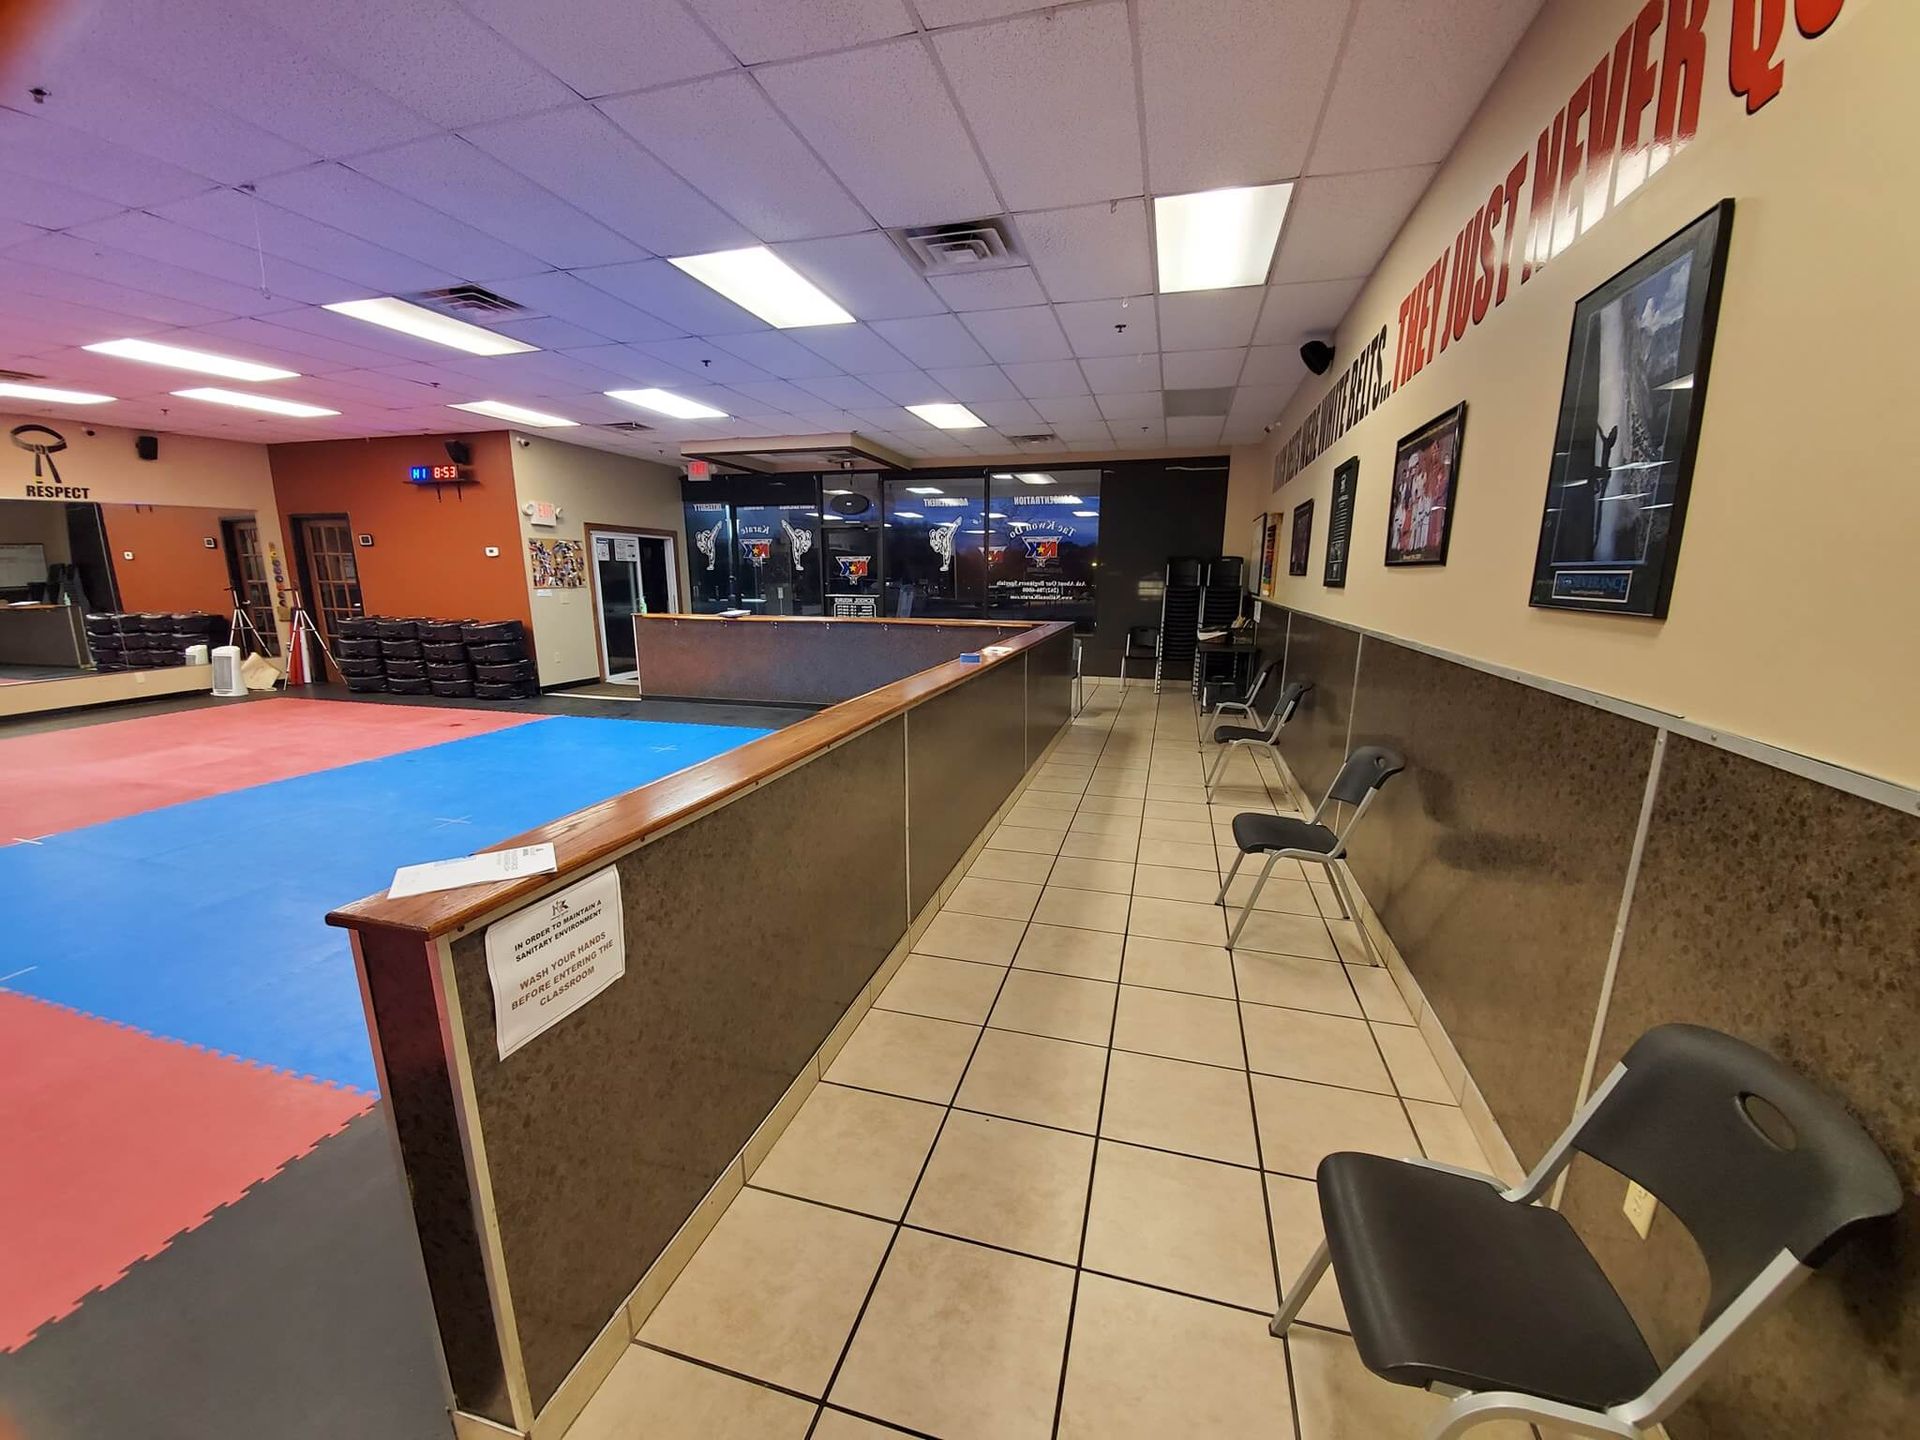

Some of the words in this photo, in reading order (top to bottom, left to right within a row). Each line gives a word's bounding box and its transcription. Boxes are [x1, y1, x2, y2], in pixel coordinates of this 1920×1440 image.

[1393, 247, 1450, 394] THEY
[1440, 153, 1528, 353] JUST
[1521, 0, 1709, 285] NEVER
[26, 485, 90, 499] RESPECT
[434, 466, 456, 479] 8:53
[514, 939, 523, 952] IN
[525, 927, 551, 946] ORDER
[552, 921, 562, 934] TO
[563, 904, 596, 928] MAINTAIN
[596, 899, 602, 908] A
[515, 937, 553, 963] SANITARY
[554, 908, 602, 942] ENVIRONMENT
[511, 978, 551, 1011] BEFORE
[553, 951, 598, 986] ENTERING
[598, 939, 614, 956] THE
[520, 967, 549, 991] WASH
[550, 949, 576, 972] YOUR
[578, 931, 607, 954] HANDS
[539, 965, 596, 1007] CLASSROOM
